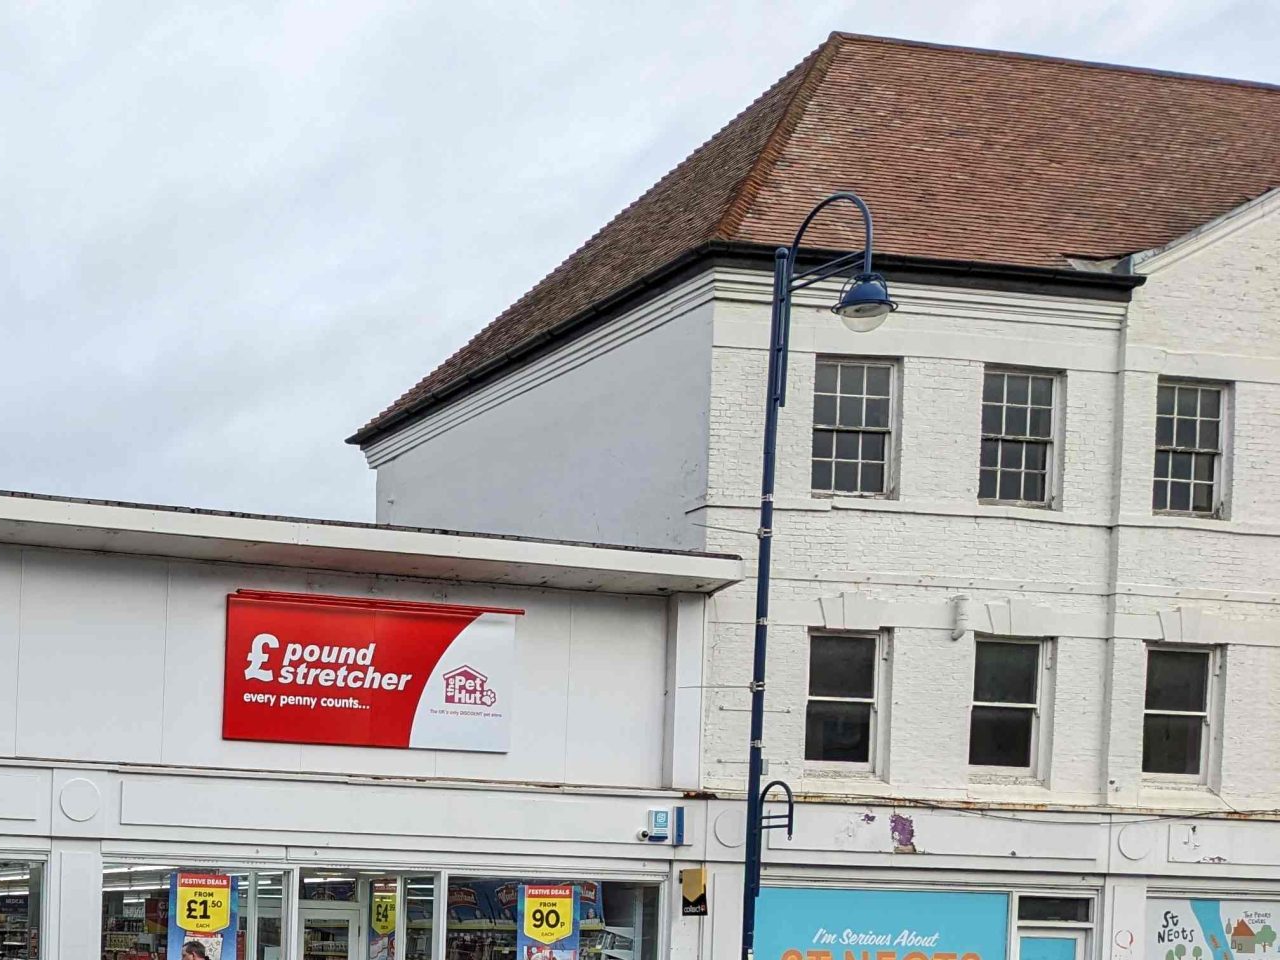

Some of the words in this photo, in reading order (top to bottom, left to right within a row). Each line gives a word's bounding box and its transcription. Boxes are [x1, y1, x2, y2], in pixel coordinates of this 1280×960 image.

[283, 643, 376, 666] pound
[278, 662, 412, 690] stretcher
[454, 675, 482, 690] Pet
[446, 678, 455, 697] the
[454, 689, 482, 704] Hut
[243, 692, 276, 706] every
[280, 694, 317, 709] penny
[532, 909, 565, 928] 90p
[1162, 910, 1179, 928] St
[812, 928, 837, 944] I'm
[839, 929, 891, 946] Serious
[893, 930, 940, 947] About
